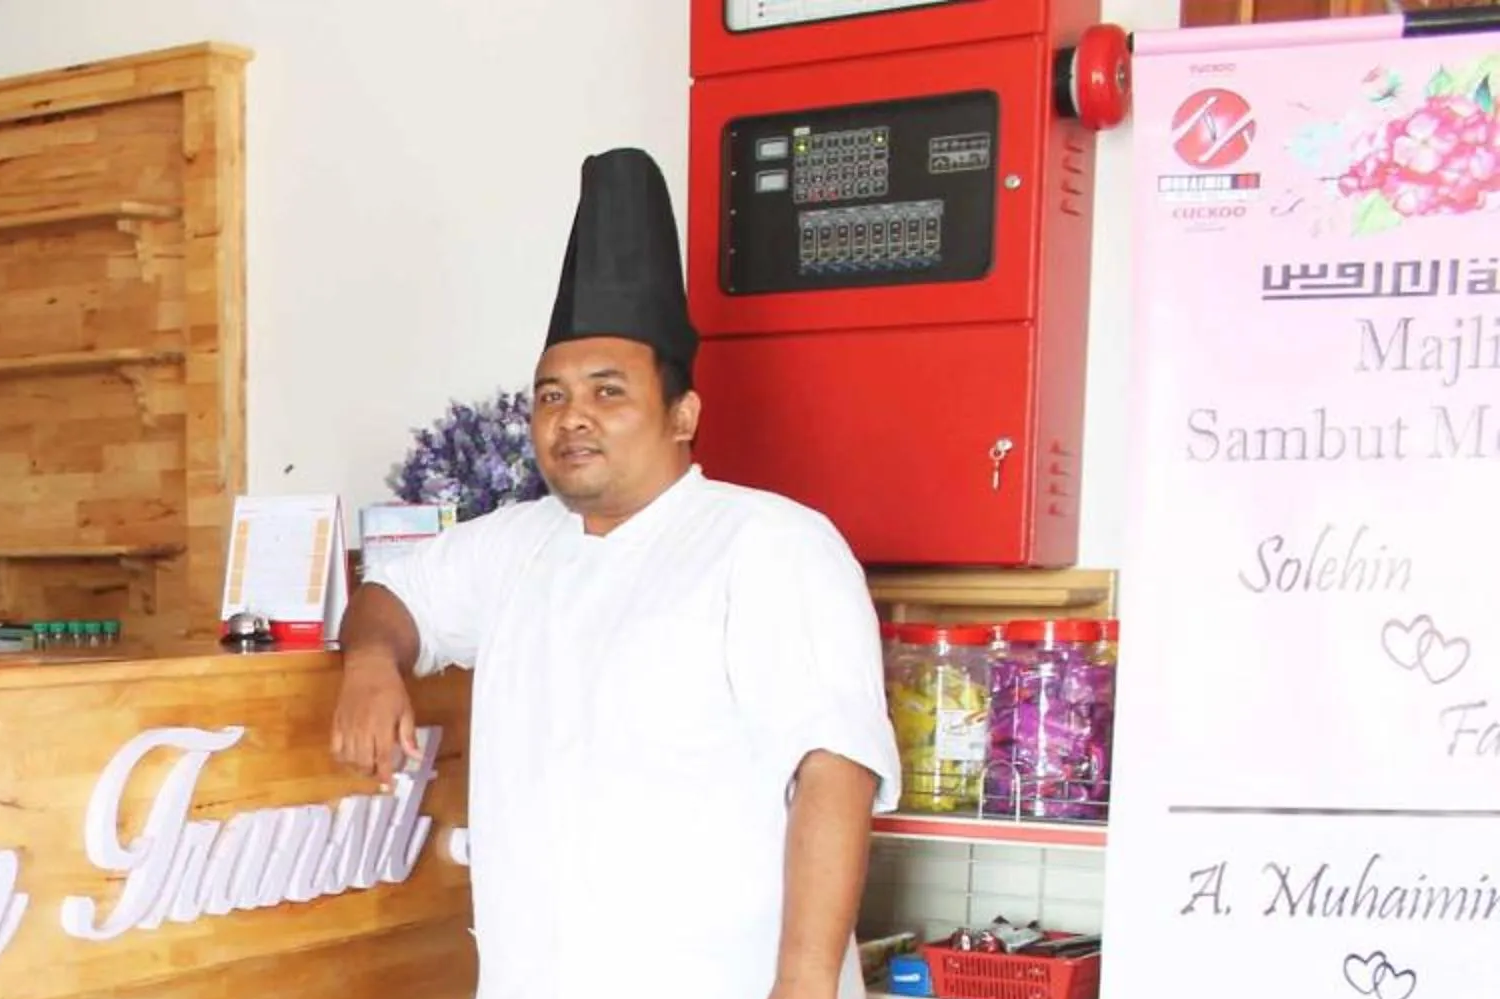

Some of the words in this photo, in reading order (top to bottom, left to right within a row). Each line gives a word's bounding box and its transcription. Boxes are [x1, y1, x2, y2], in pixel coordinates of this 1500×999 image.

[1187, 407, 1409, 462] Sambut
[1425, 403, 1500, 462] M
[1238, 523, 1413, 594] Solehin
[1181, 862, 1232, 915] A.
